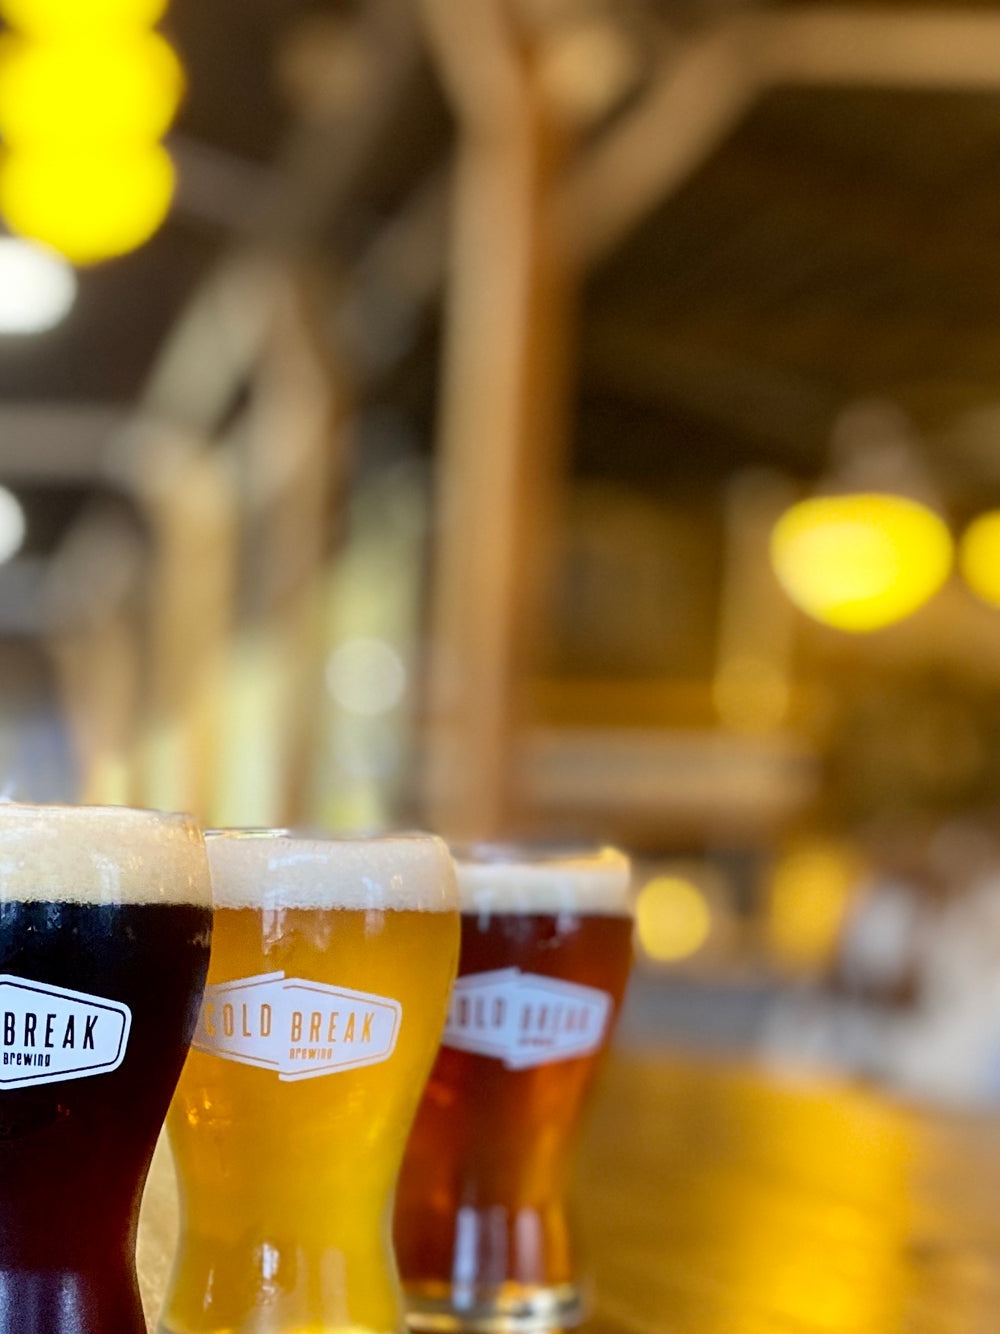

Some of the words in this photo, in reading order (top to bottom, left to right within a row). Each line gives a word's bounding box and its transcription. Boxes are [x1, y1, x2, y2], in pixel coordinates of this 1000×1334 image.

[3, 1011, 99, 1050] BREAK
[205, 1003, 272, 1038] COLD
[290, 1011, 376, 1044] BREAK
